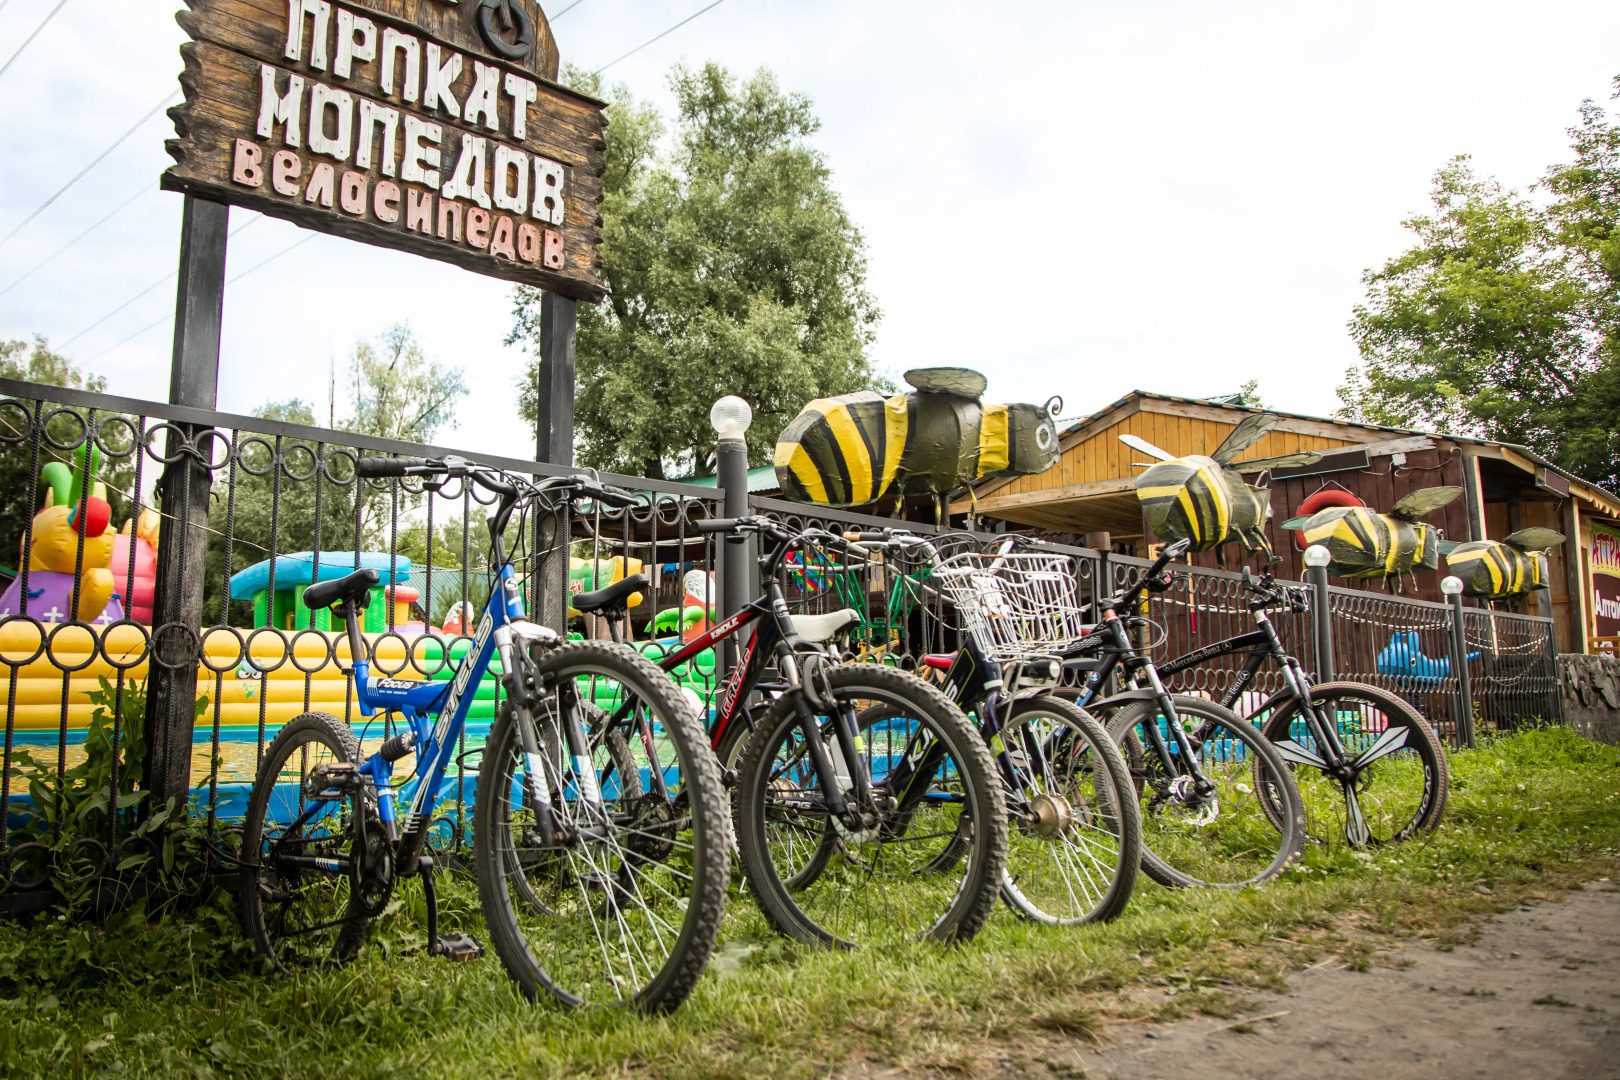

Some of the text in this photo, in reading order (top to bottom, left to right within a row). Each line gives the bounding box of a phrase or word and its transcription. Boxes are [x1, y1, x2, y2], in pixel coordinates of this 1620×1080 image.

[256, 63, 565, 226] МОПЕДОВ
[710, 617, 740, 640] KINDLE
[1170, 645, 1222, 669] Mercedes-Benz
[721, 647, 750, 719] RACER
